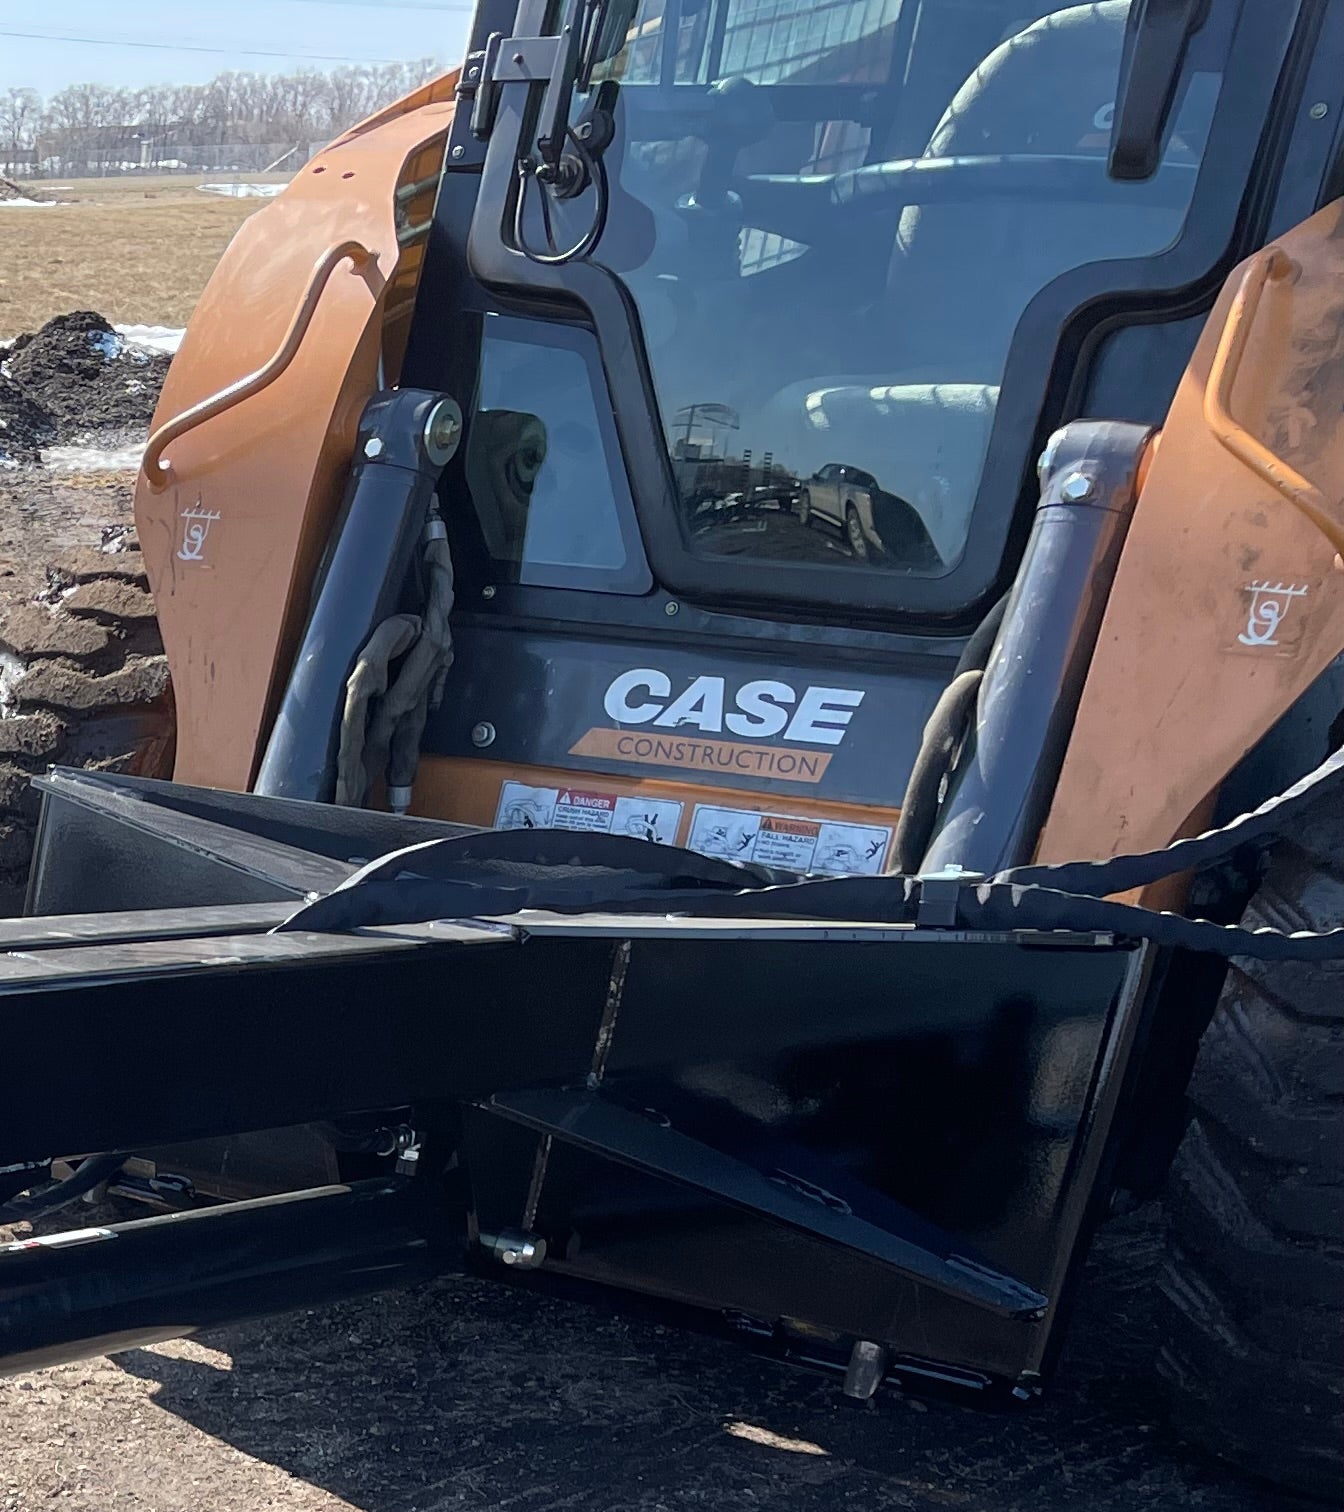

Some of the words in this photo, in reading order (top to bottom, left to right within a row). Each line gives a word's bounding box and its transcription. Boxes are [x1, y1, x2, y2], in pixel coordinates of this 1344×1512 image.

[604, 669, 865, 745] CASE
[617, 736, 819, 776] CONSTRUCTION
[573, 796, 611, 809] DANGER
[581, 809, 610, 818] HAZARD
[775, 821, 818, 836] WARNING
[761, 832, 779, 841] FALL
[782, 835, 815, 845] HAZARD
